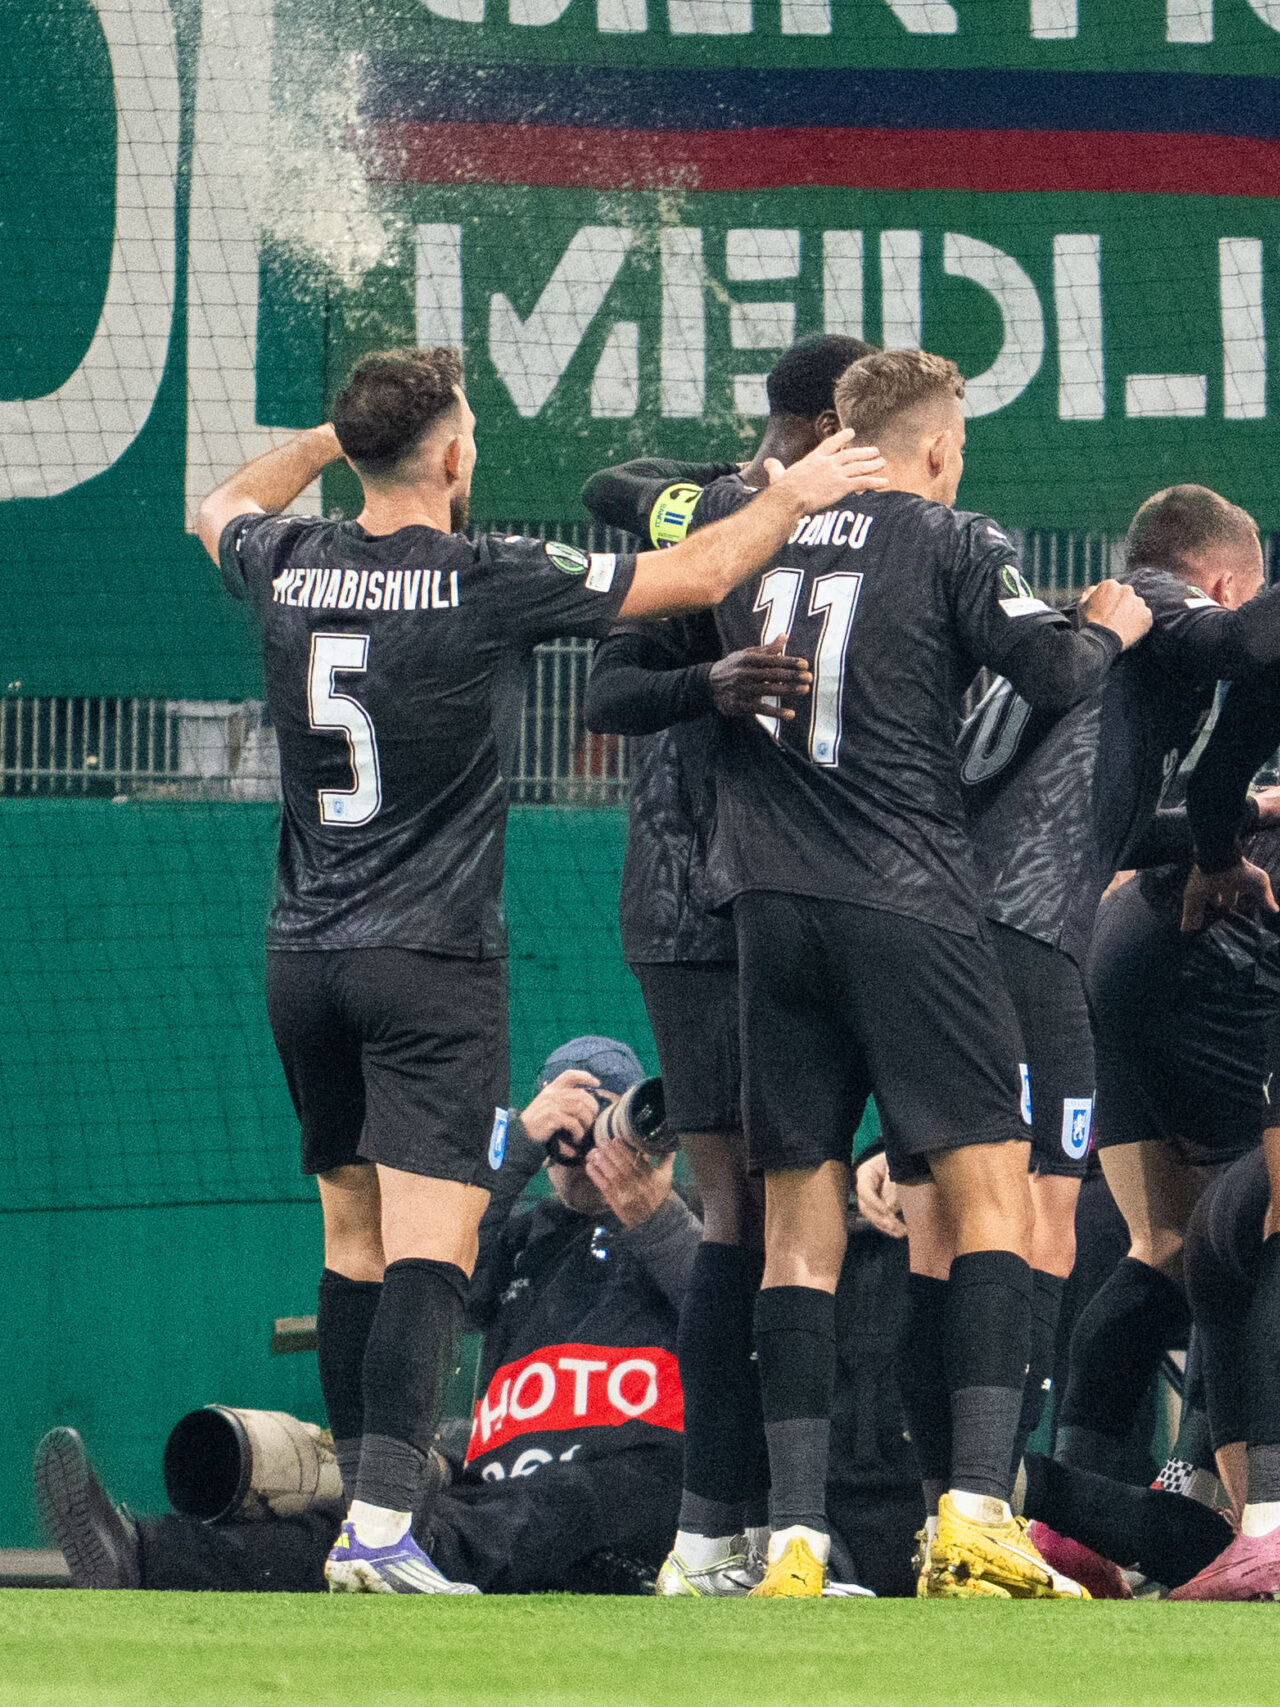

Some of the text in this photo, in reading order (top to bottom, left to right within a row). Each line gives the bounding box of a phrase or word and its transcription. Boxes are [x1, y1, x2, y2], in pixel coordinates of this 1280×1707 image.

[307, 632, 383, 827] 5
[753, 566, 864, 768] 11
[471, 1357, 659, 1443] HOTO
